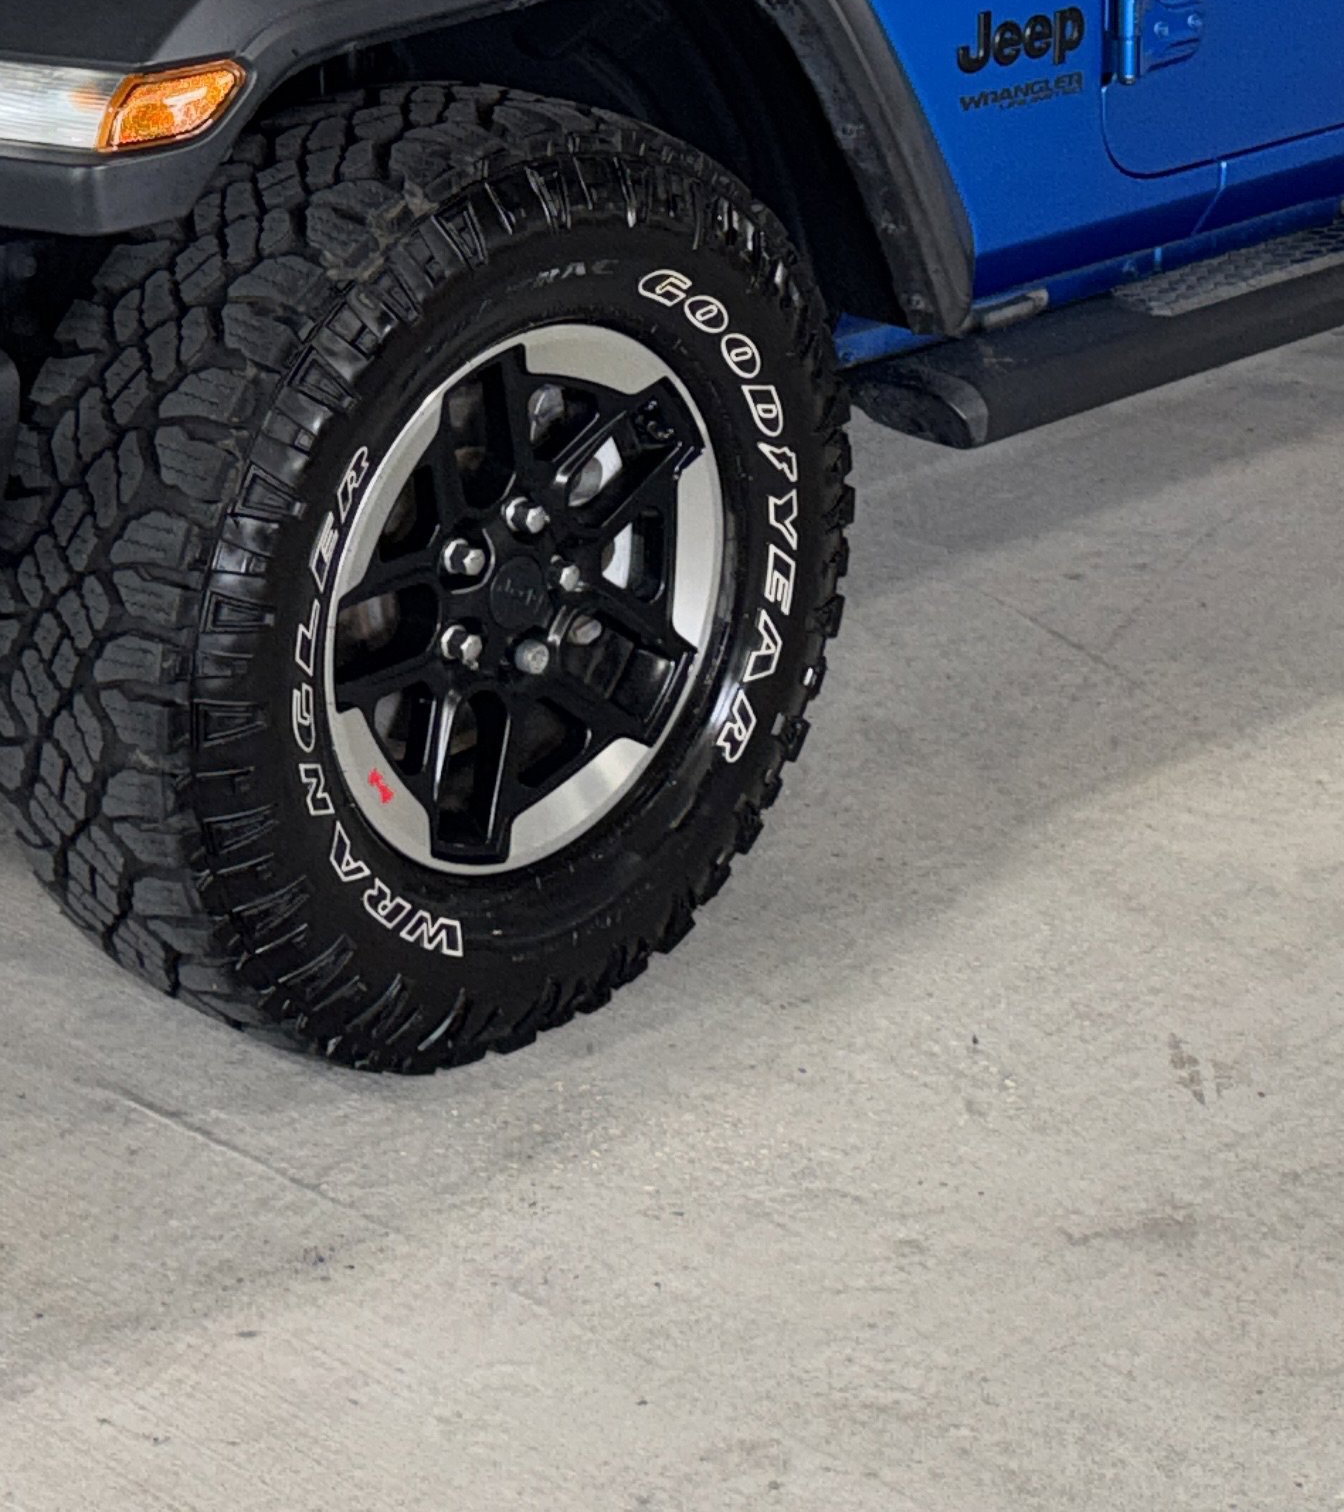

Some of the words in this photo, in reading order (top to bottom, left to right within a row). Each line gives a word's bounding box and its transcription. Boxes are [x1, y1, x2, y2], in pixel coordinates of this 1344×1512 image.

[957, 6, 1085, 74] Jeep
[959, 71, 1083, 112] WRANGLER
[638, 268, 799, 764] GOODYEAR
[292, 446, 464, 957] WRANGLER
